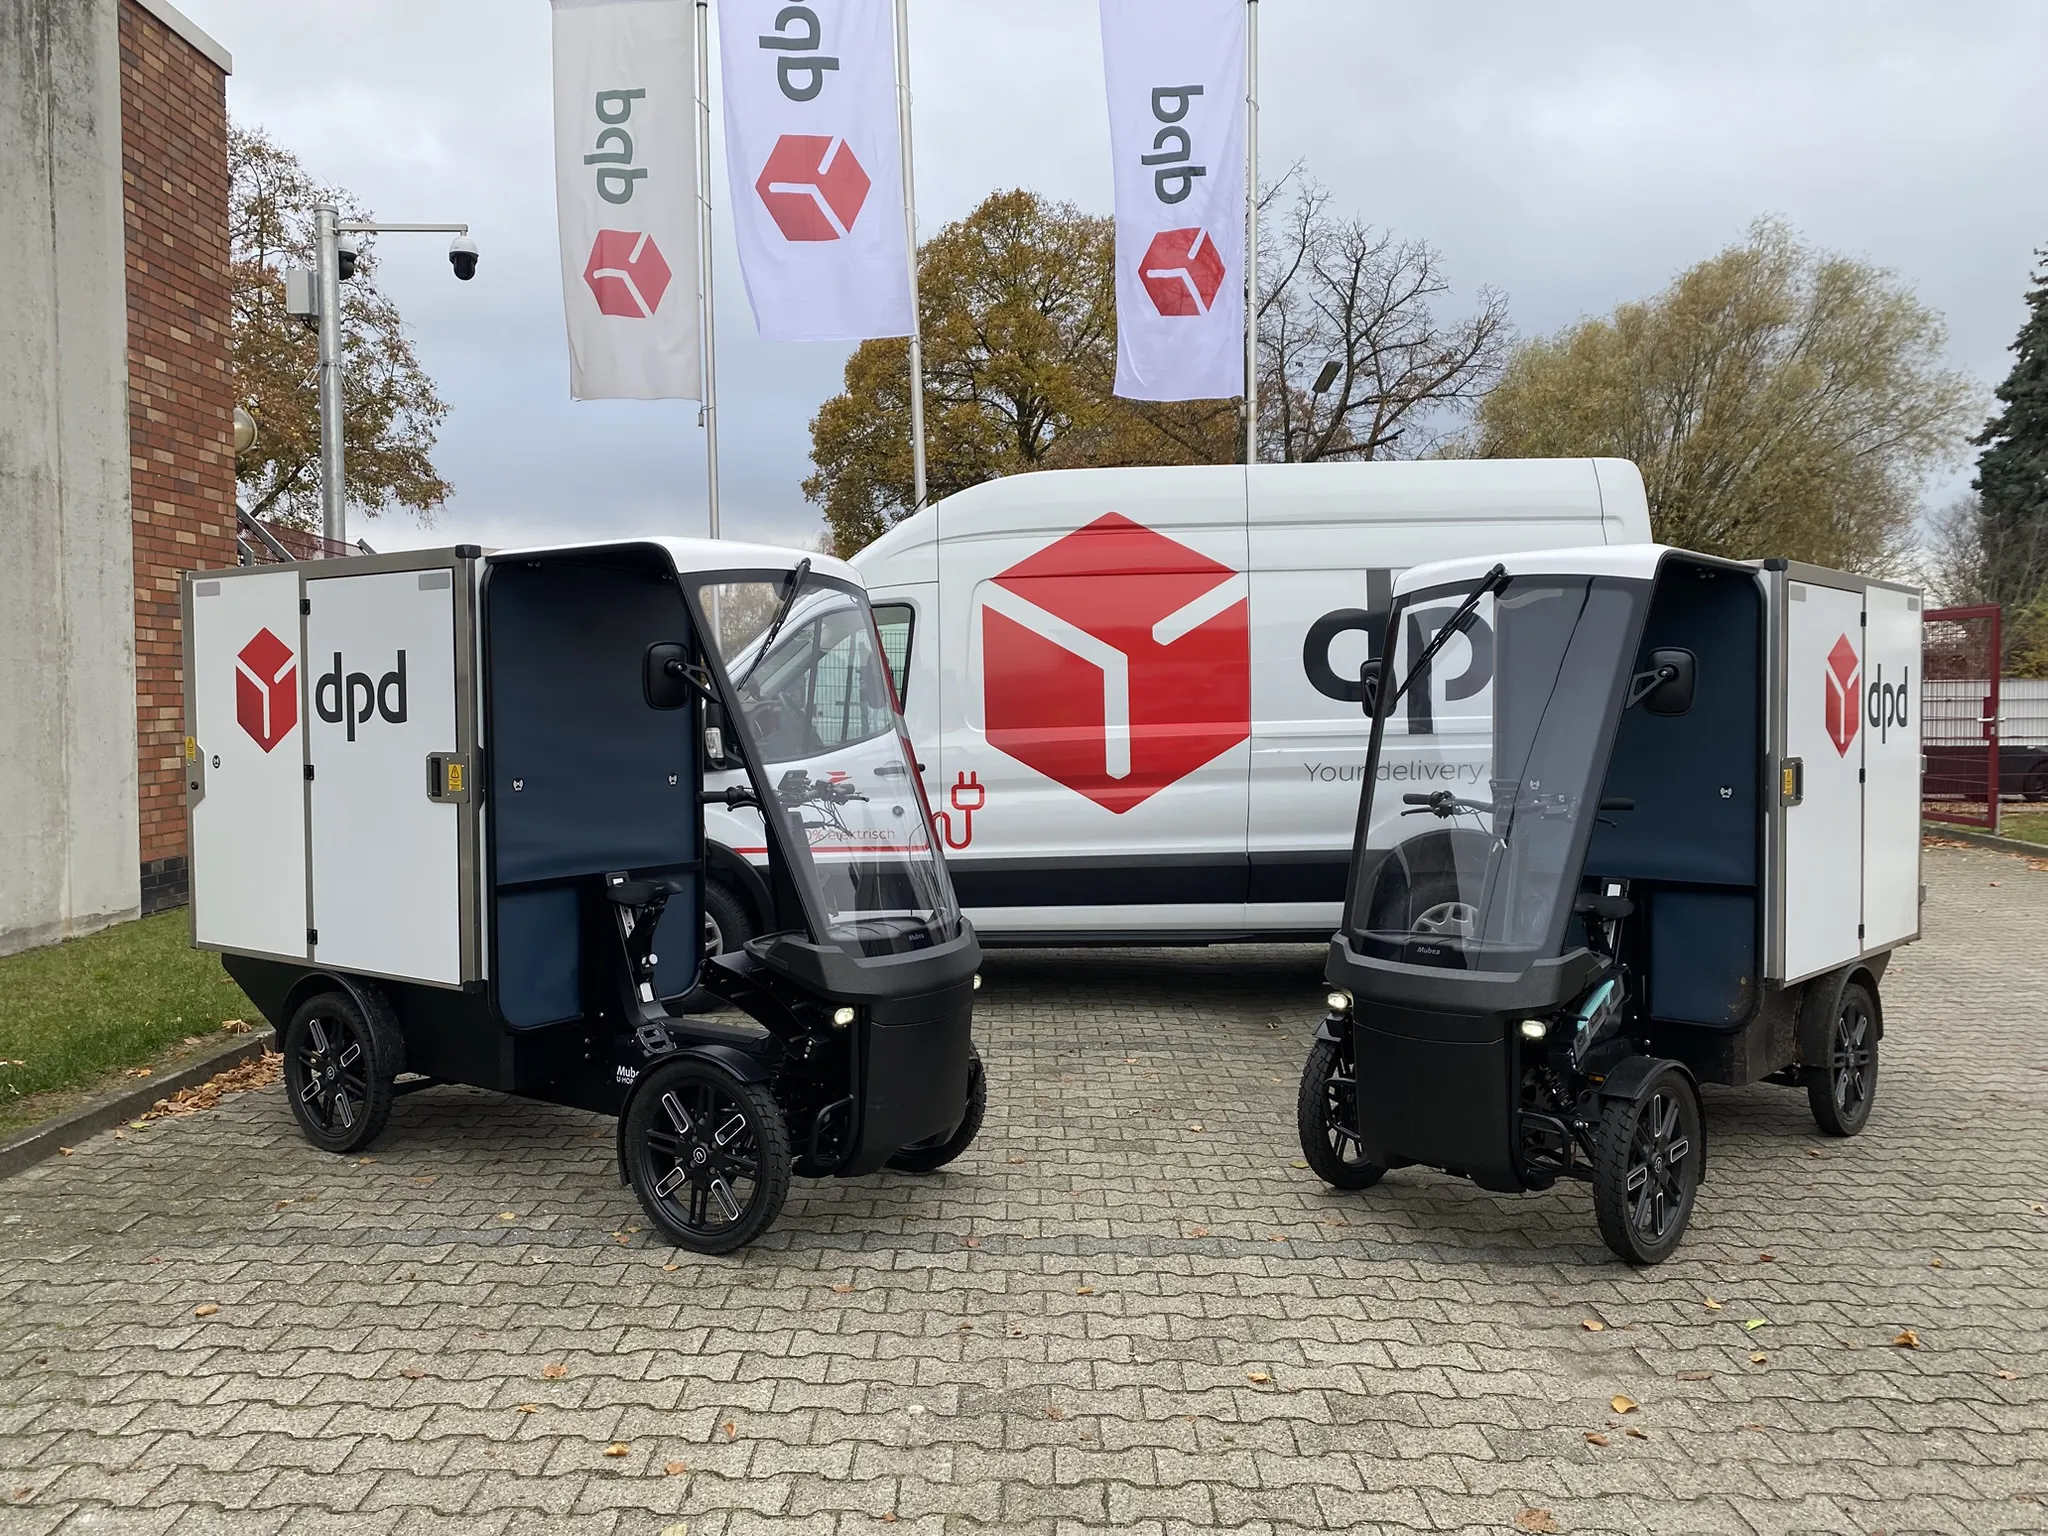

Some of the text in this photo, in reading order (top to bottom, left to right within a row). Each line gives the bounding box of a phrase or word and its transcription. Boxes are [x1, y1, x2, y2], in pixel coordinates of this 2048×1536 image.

[1303, 569, 1494, 734] dp
[315, 649, 407, 742] dpd
[1868, 663, 1908, 744] dpd
[1304, 760, 1484, 785] Your delivery
[828, 828, 895, 841] elektrisch
[1416, 946, 1441, 955] Mubea
[616, 1065, 639, 1078] Mub
